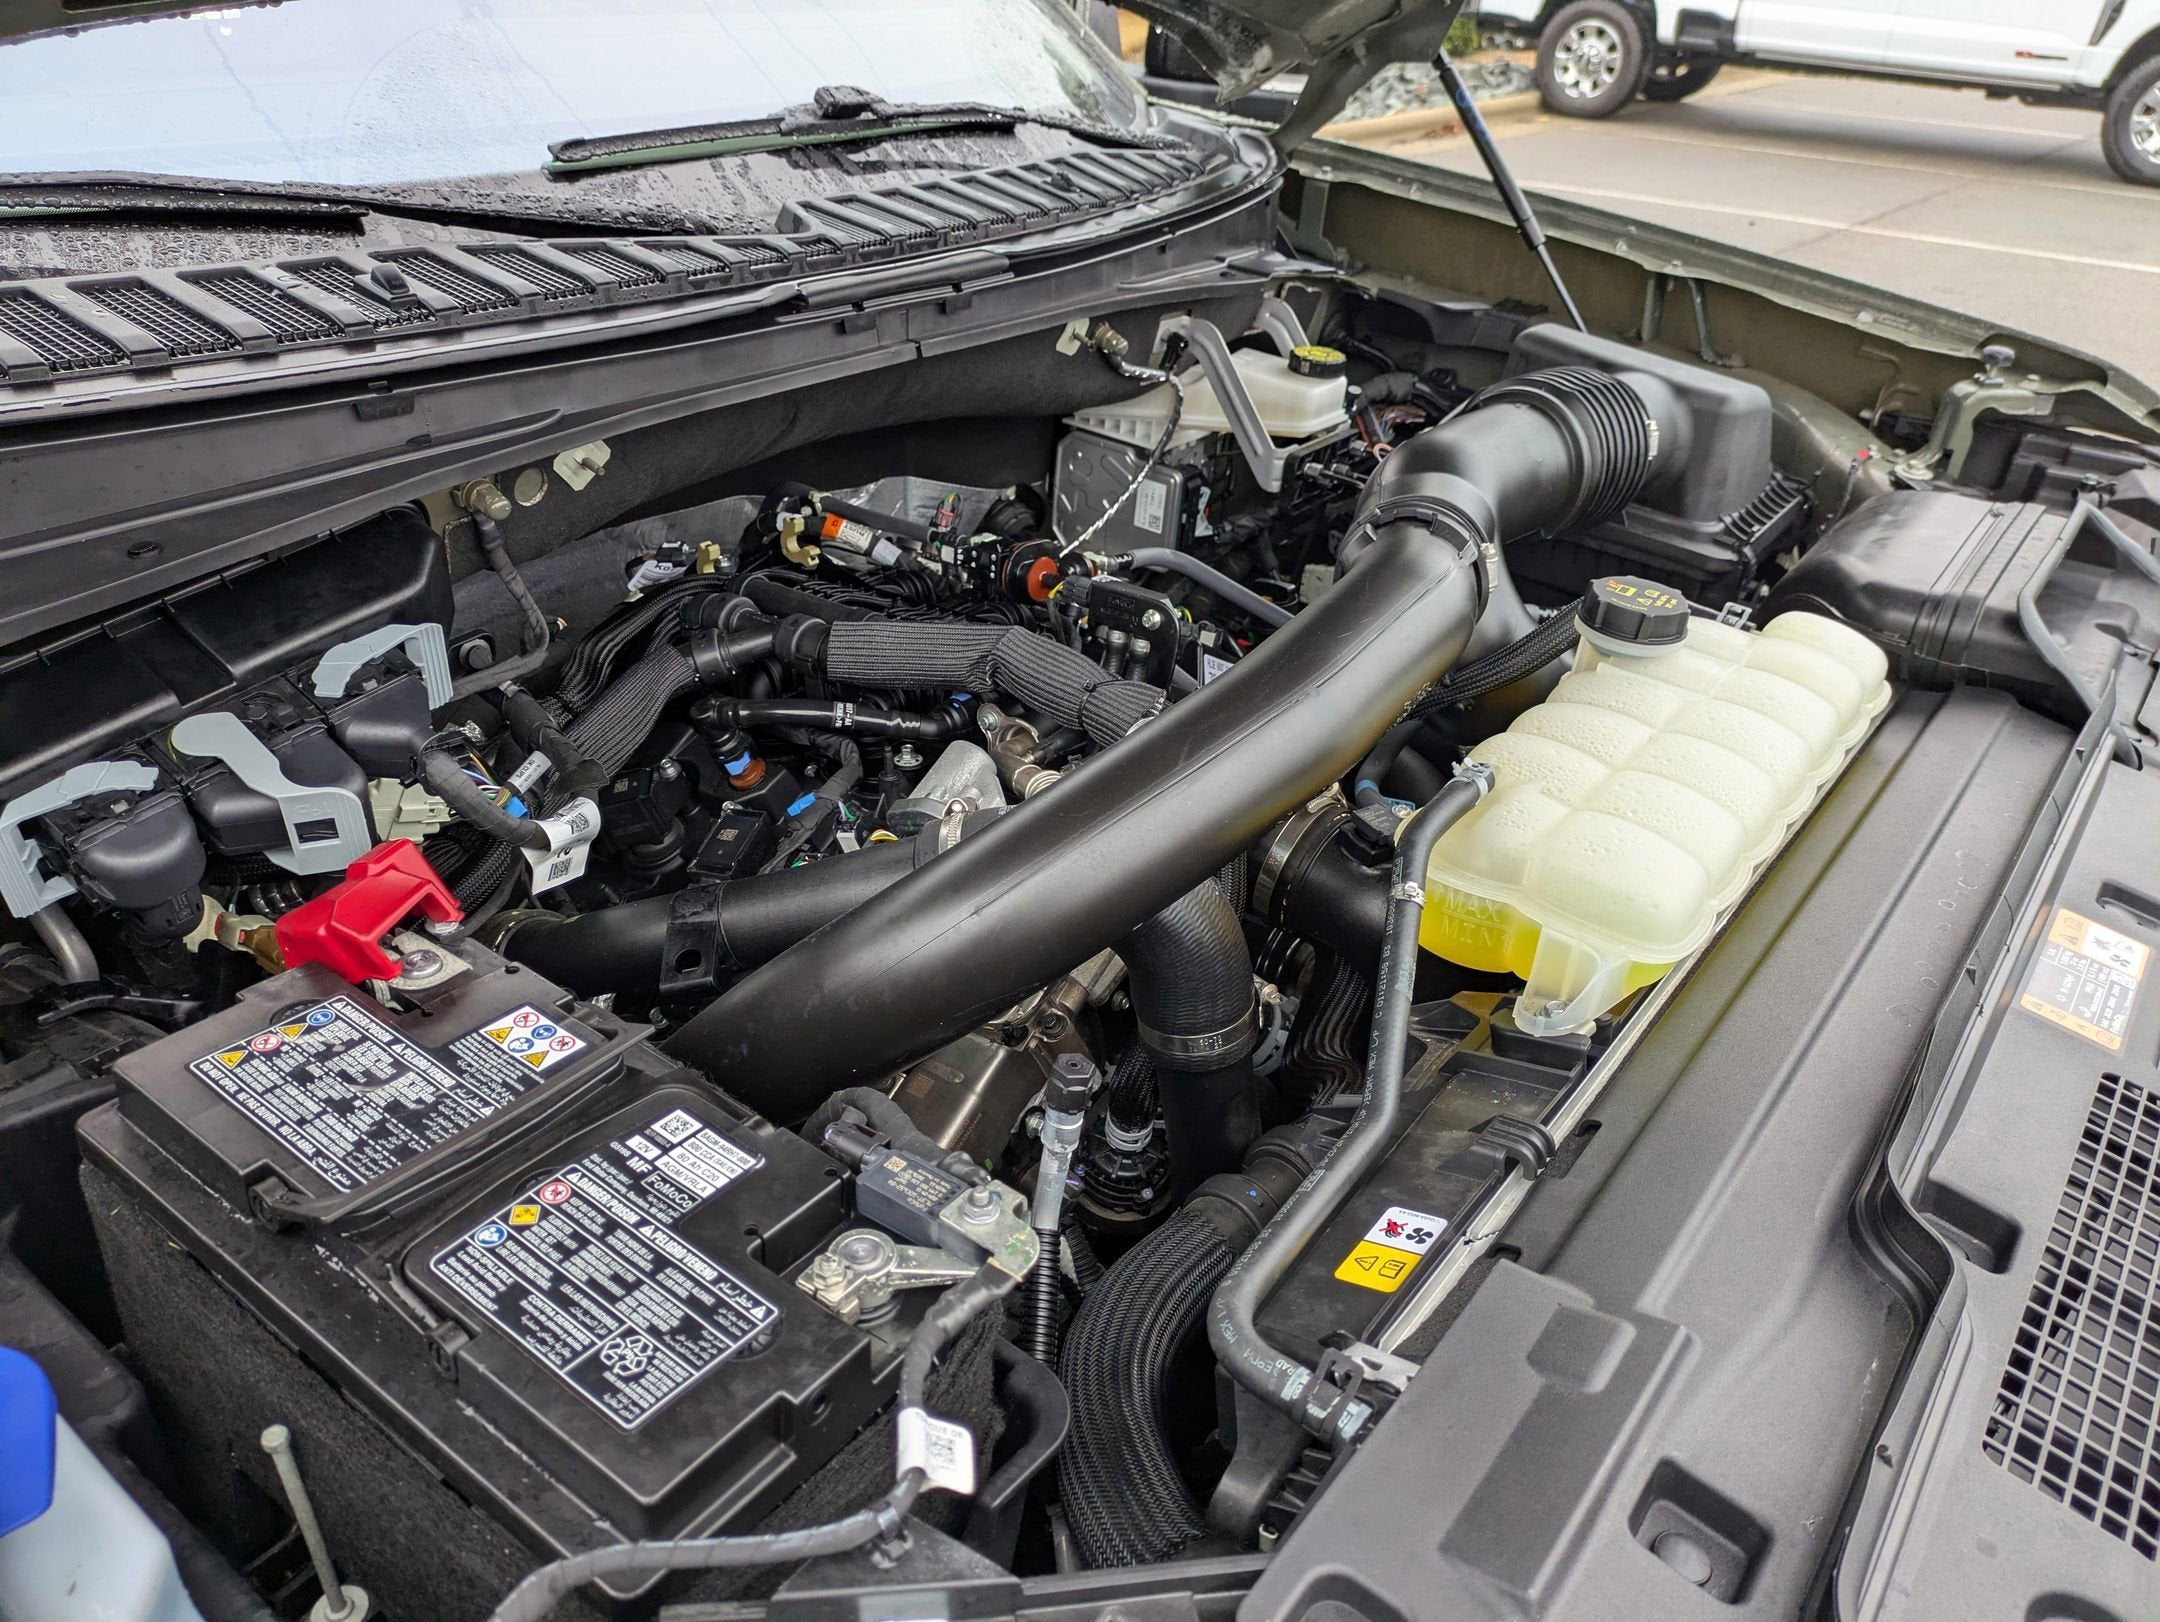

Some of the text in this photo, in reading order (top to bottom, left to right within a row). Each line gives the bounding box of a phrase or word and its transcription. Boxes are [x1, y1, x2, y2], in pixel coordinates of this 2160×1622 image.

[1445, 890, 1501, 923] MAX
[1440, 917, 1498, 949] MIN
[338, 1004, 395, 1043] DANGER/POISON
[197, 1061, 214, 1072] DO
[205, 1067, 226, 1081] NOT
[397, 1047, 457, 1088] PELIGRO/VENENO
[216, 1076, 242, 1094] OPEN.
[234, 1091, 284, 1127] NE PAS OUVRIR.
[276, 1124, 320, 1157] NO LA ABRA.
[633, 1140, 654, 1154] 12V
[698, 1149, 717, 1161] CCA
[624, 1155, 654, 1176] MF
[658, 1159, 709, 1193] AGM/VRLA
[675, 1152, 721, 1182] 80 Ah C20
[573, 1176, 643, 1225] DANGER/POISON
[645, 1174, 696, 1209] FoMoCo
[436, 1261, 457, 1277] ANTI
[455, 1249, 476, 1265] Lead
[468, 1260, 489, 1276] Acid
[464, 1244, 516, 1286] NON-SPILLABLE
[647, 1229, 721, 1281] PELIGRO/VENENO
[525, 1293, 593, 1346] CONTRA DERRAMES
